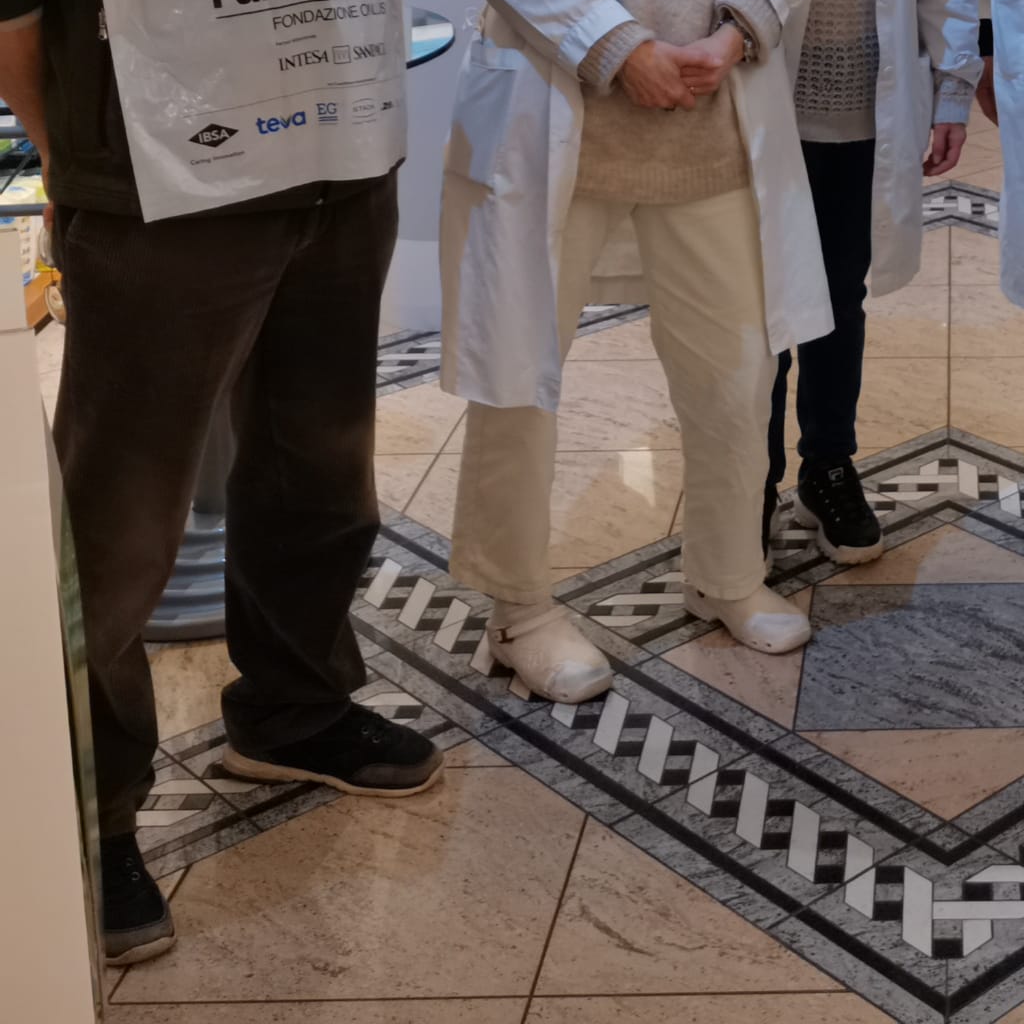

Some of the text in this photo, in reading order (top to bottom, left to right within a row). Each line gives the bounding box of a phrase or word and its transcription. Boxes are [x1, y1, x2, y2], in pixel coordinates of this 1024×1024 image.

[272, 6, 358, 30] FONDAZIONE
[279, 50, 330, 72] INTESA
[316, 102, 338, 116] EG
[256, 111, 307, 135] teva
[197, 128, 230, 144] IBSA
